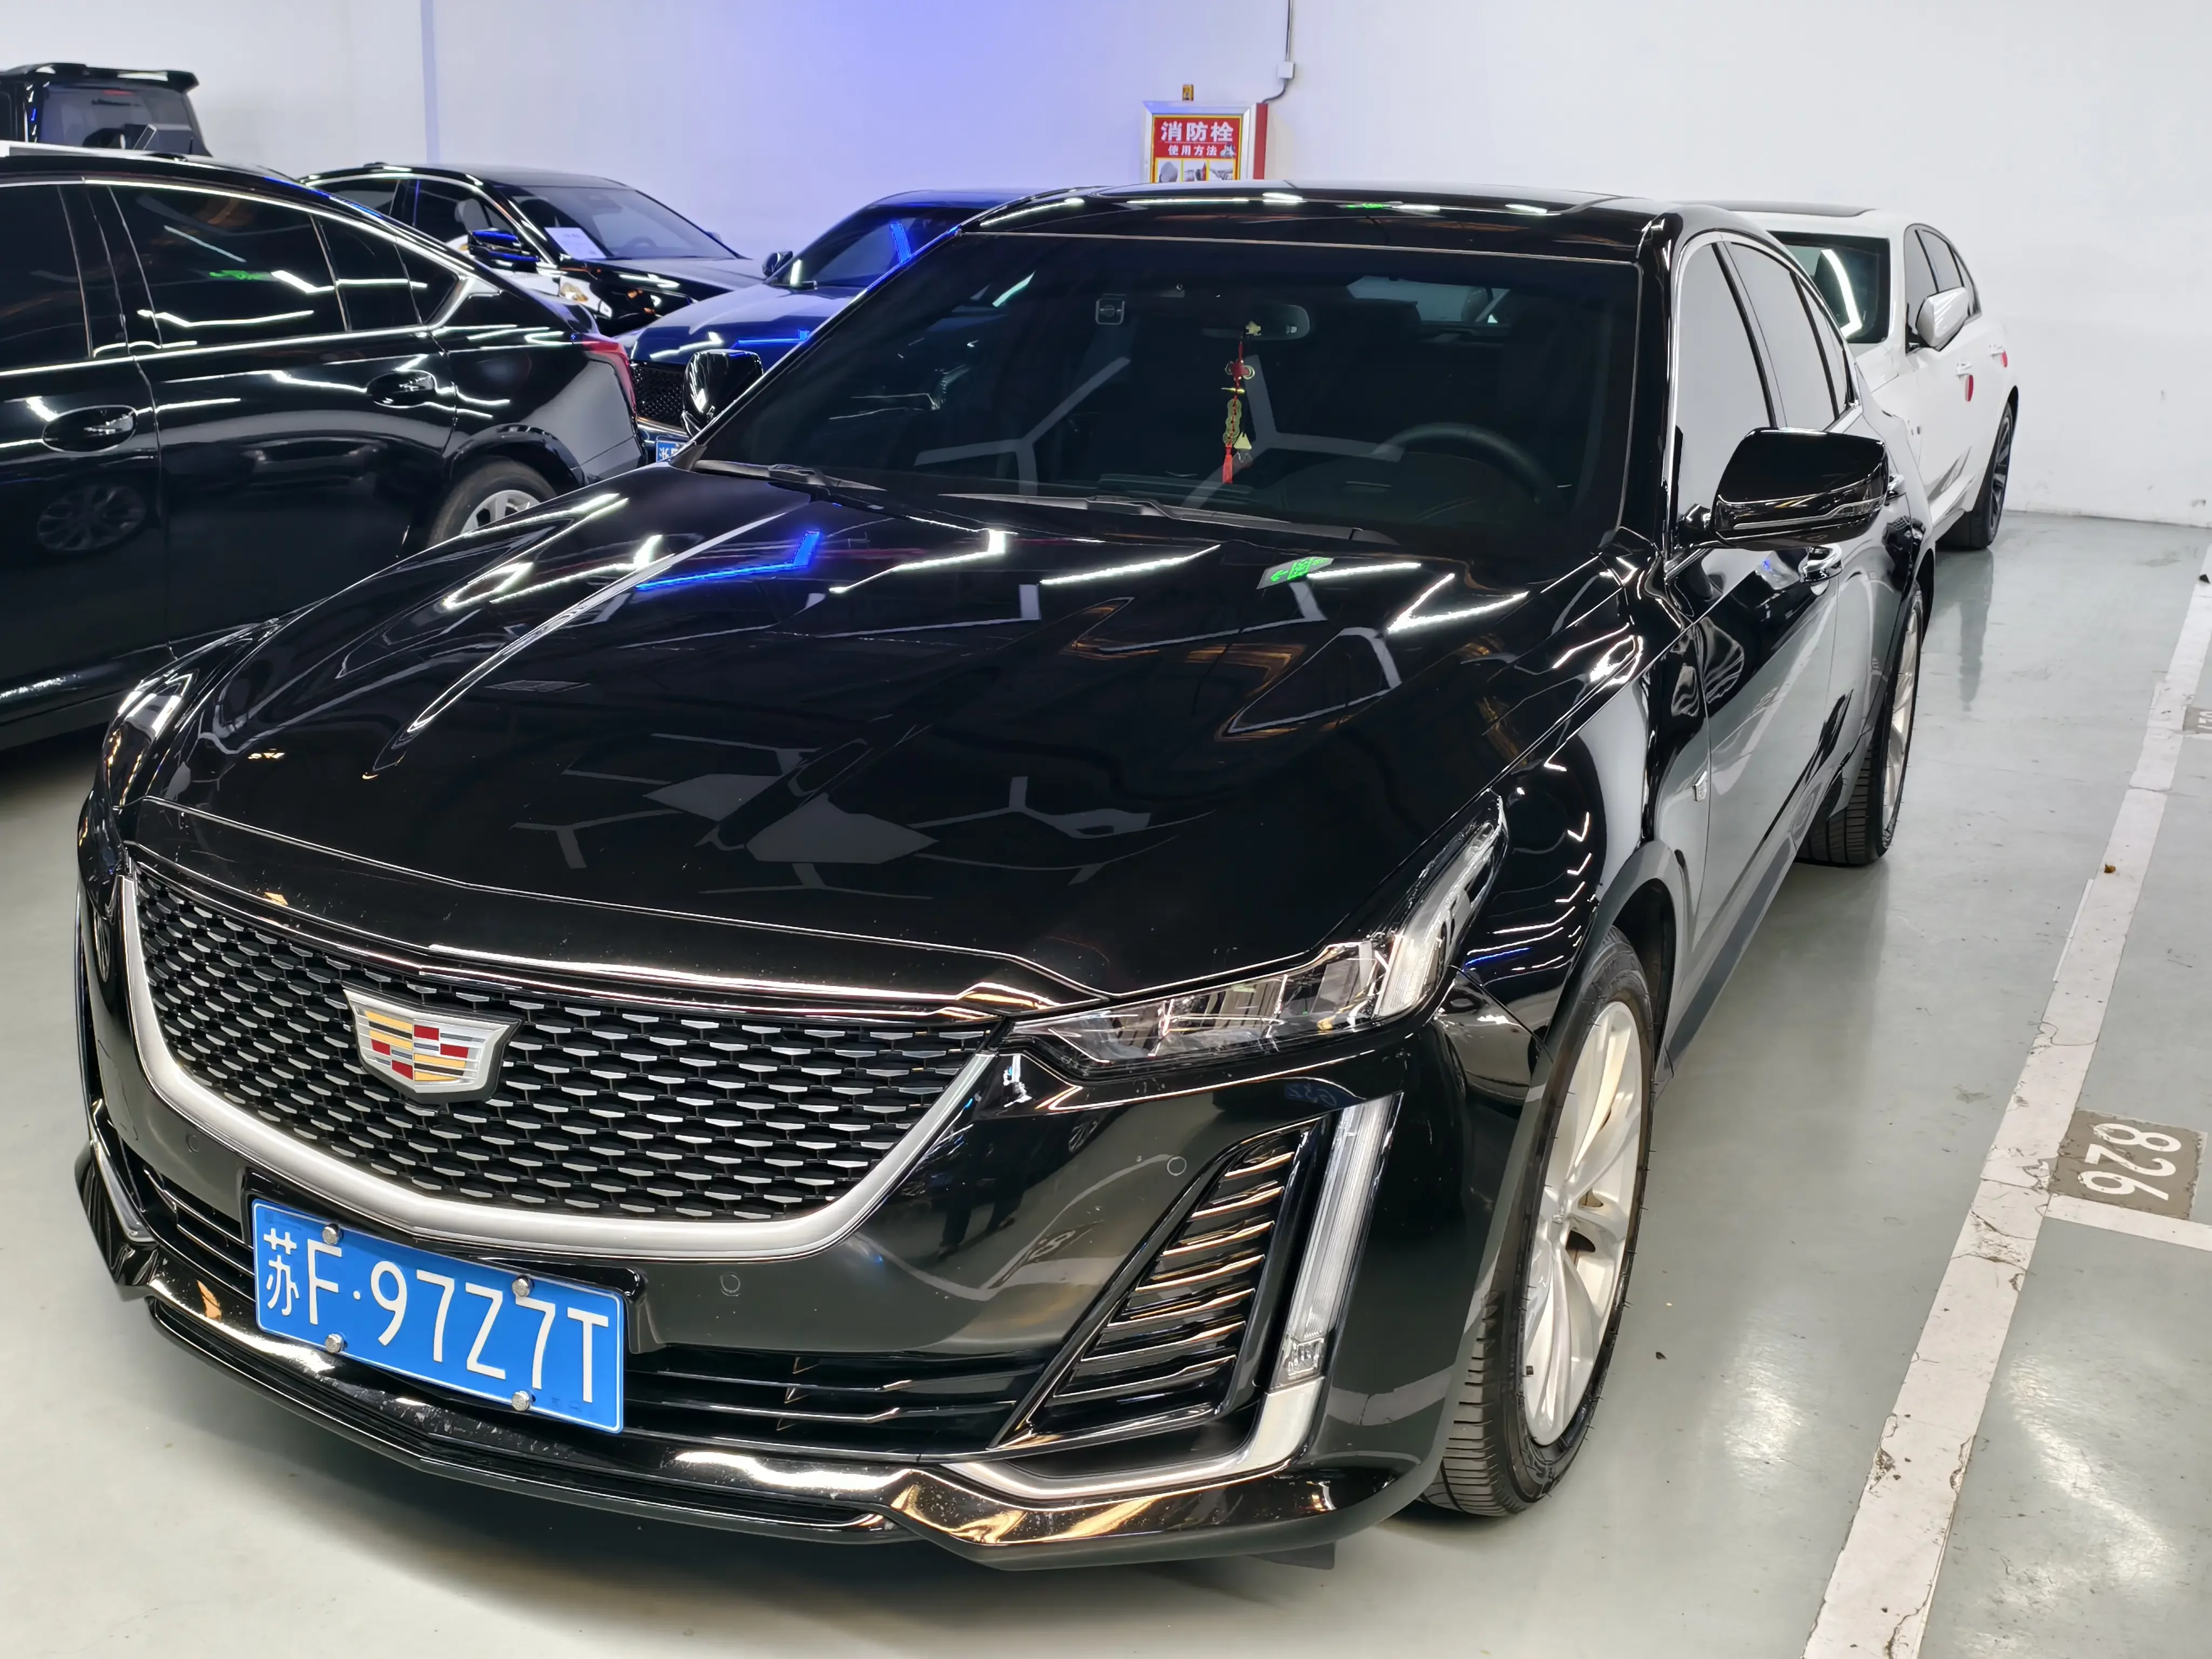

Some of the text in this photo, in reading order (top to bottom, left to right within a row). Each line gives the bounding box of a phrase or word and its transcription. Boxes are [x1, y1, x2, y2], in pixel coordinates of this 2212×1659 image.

[1161, 121, 1234, 142] 消防栓
[1168, 145, 1217, 156] 使用方法
[2078, 1123, 2182, 1201] 826
